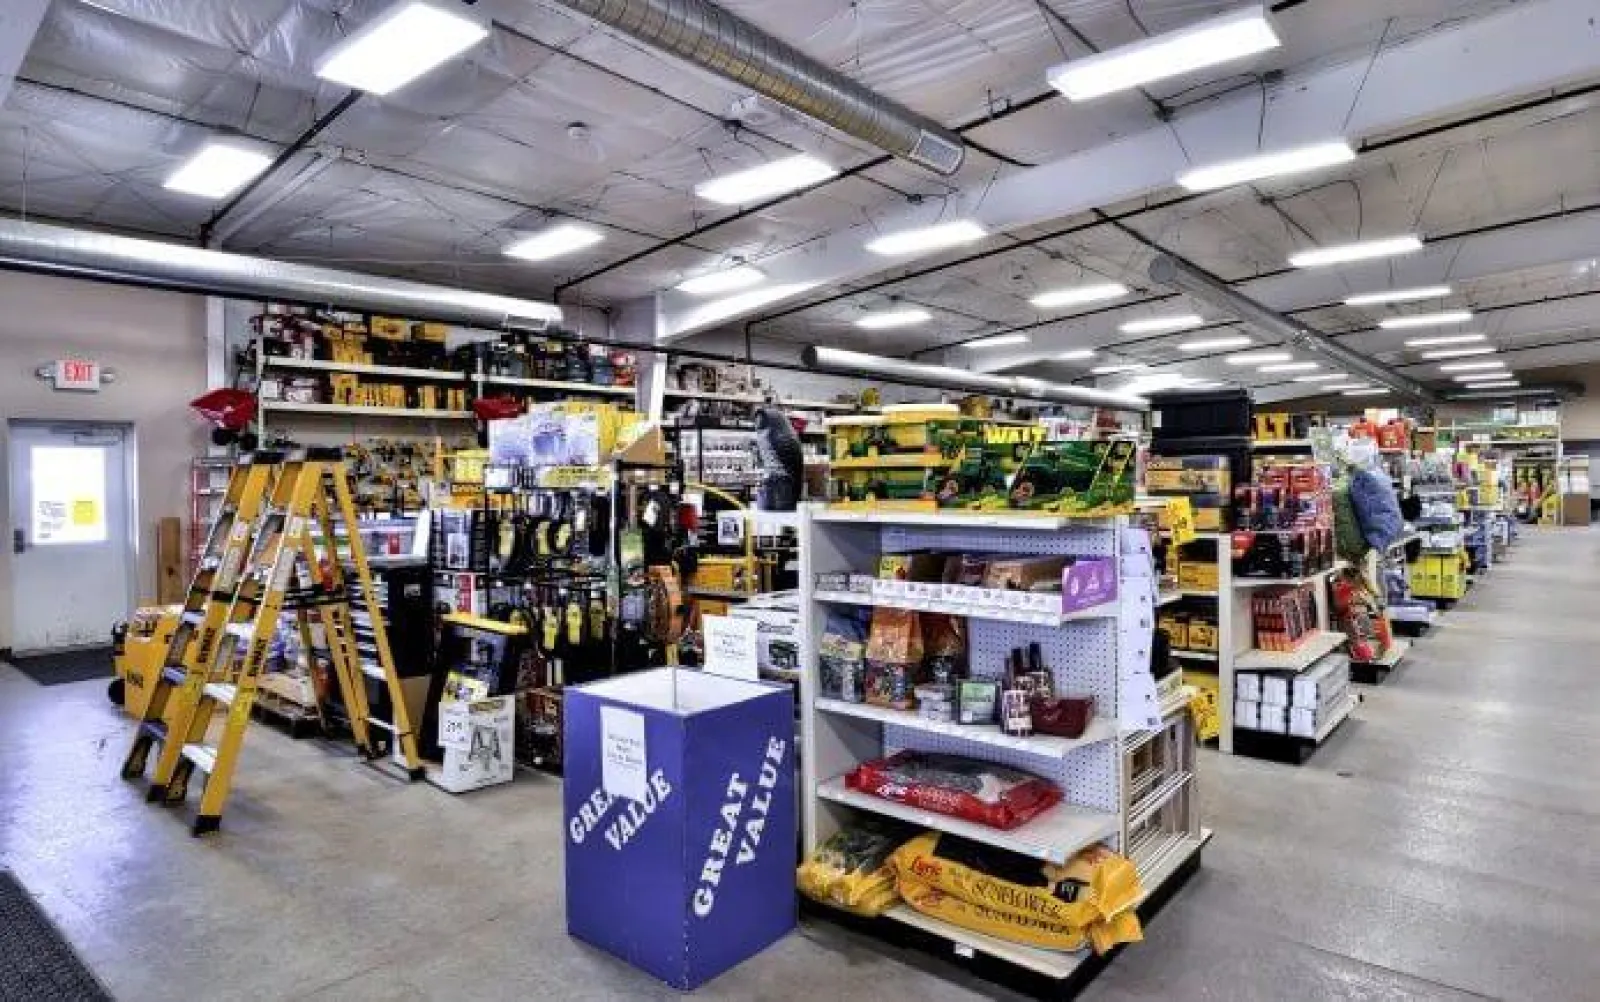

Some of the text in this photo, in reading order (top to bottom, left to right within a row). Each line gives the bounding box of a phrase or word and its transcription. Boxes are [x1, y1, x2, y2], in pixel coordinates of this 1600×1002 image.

[64, 360, 93, 381] EXIT
[604, 768, 672, 850] VALUE
[692, 772, 748, 917] GREAT
[736, 736, 786, 865] VALUE
